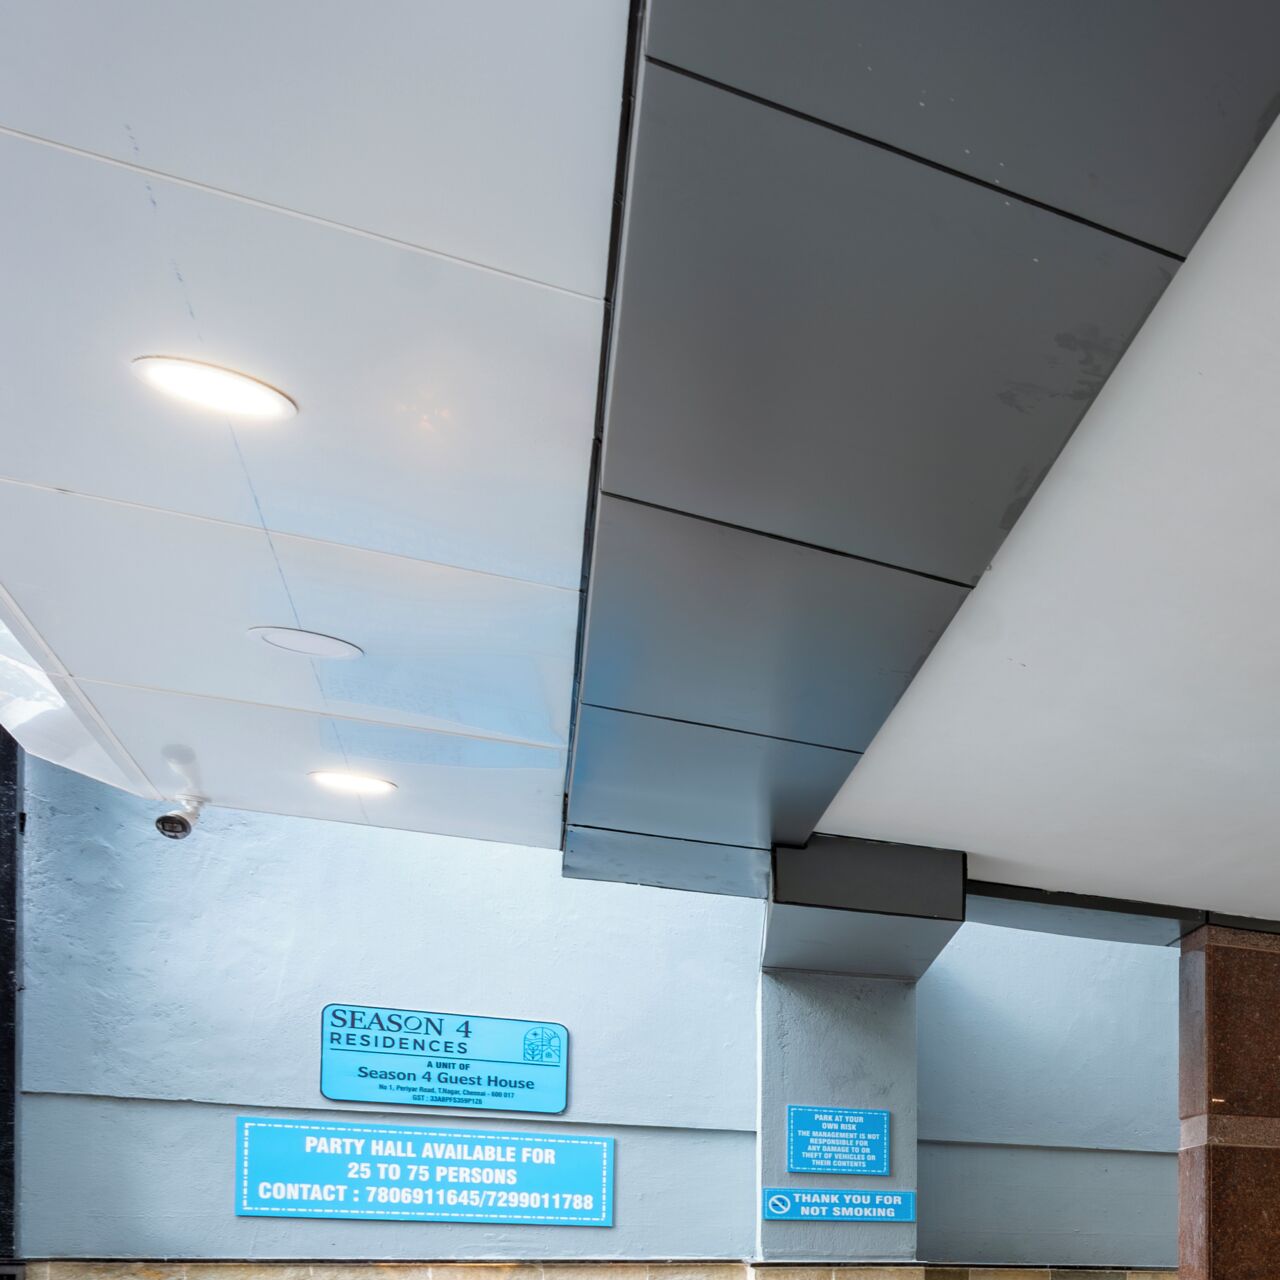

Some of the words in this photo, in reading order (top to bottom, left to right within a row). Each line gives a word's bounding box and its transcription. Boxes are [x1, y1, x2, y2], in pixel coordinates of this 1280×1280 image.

[330, 1008, 444, 1036] SEASON
[455, 1020, 472, 1038] 4
[330, 1032, 468, 1054] RESIDENCES
[426, 1060, 433, 1068] A
[436, 1061, 456, 1070] UNIT
[357, 1066, 417, 1082] Season
[422, 1071, 432, 1082] 4
[437, 1071, 482, 1087] Guest
[487, 1075, 535, 1090] House
[822, 1122, 838, 1130] OWN
[812, 1131, 858, 1139] MANAGEMENT
[809, 1138, 853, 1146] RESPONSIBLE
[305, 1136, 365, 1156] PARTY
[370, 1140, 417, 1158] HALL
[421, 1142, 516, 1163] AVAILABLE
[521, 1147, 556, 1164] FOR
[822, 1145, 849, 1153] DAMAGE
[802, 1151, 822, 1159] THEFT
[347, 1162, 371, 1179] 25
[376, 1163, 401, 1180] TO
[407, 1165, 430, 1182] 75
[436, 1167, 517, 1185] PERSONS
[258, 1182, 348, 1203] CONTACT
[352, 1188, 359, 1203] :
[366, 1186, 594, 1211] 7806911645/7299011788
[793, 1193, 841, 1204] THANK
[843, 1194, 871, 1204] YOU
[876, 1195, 902, 1205] FOR
[800, 1206, 828, 1216] NOT
[832, 1207, 895, 1217] SMOKING
